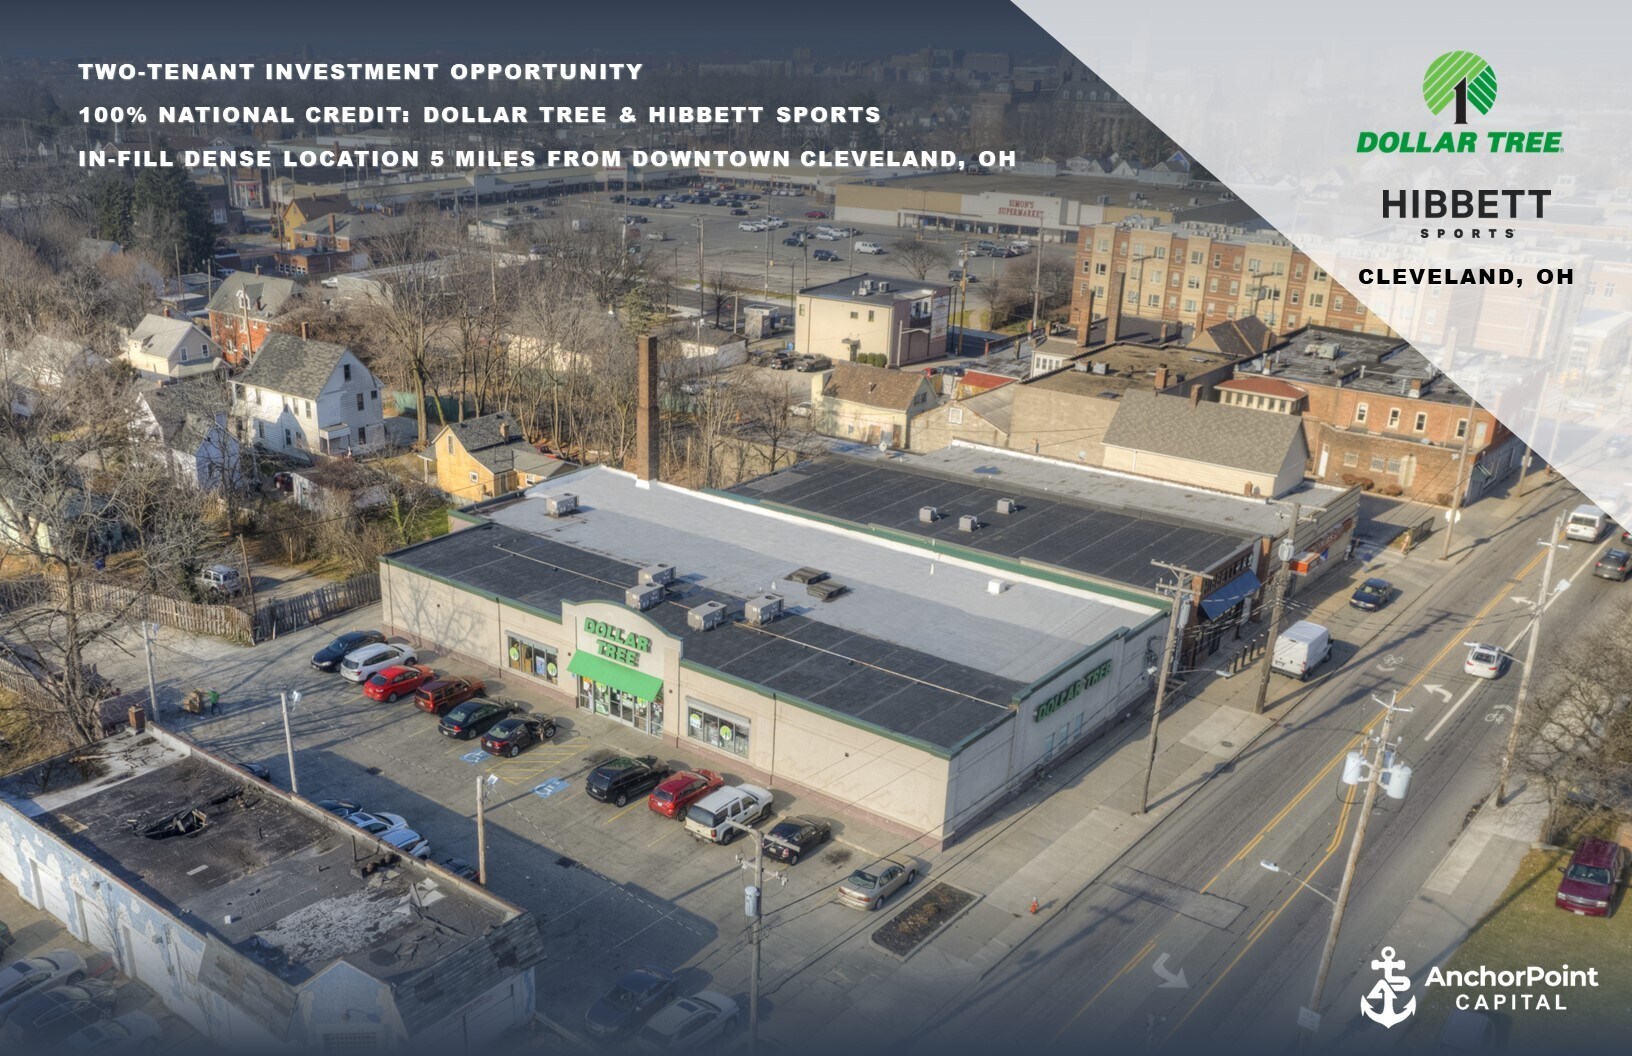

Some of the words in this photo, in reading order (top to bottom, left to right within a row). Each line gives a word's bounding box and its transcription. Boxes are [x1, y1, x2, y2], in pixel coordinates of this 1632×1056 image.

[998, 207, 1044, 218] SUPERMARKE
[584, 617, 653, 653] DOLLAR
[597, 638, 640, 667] TREE
